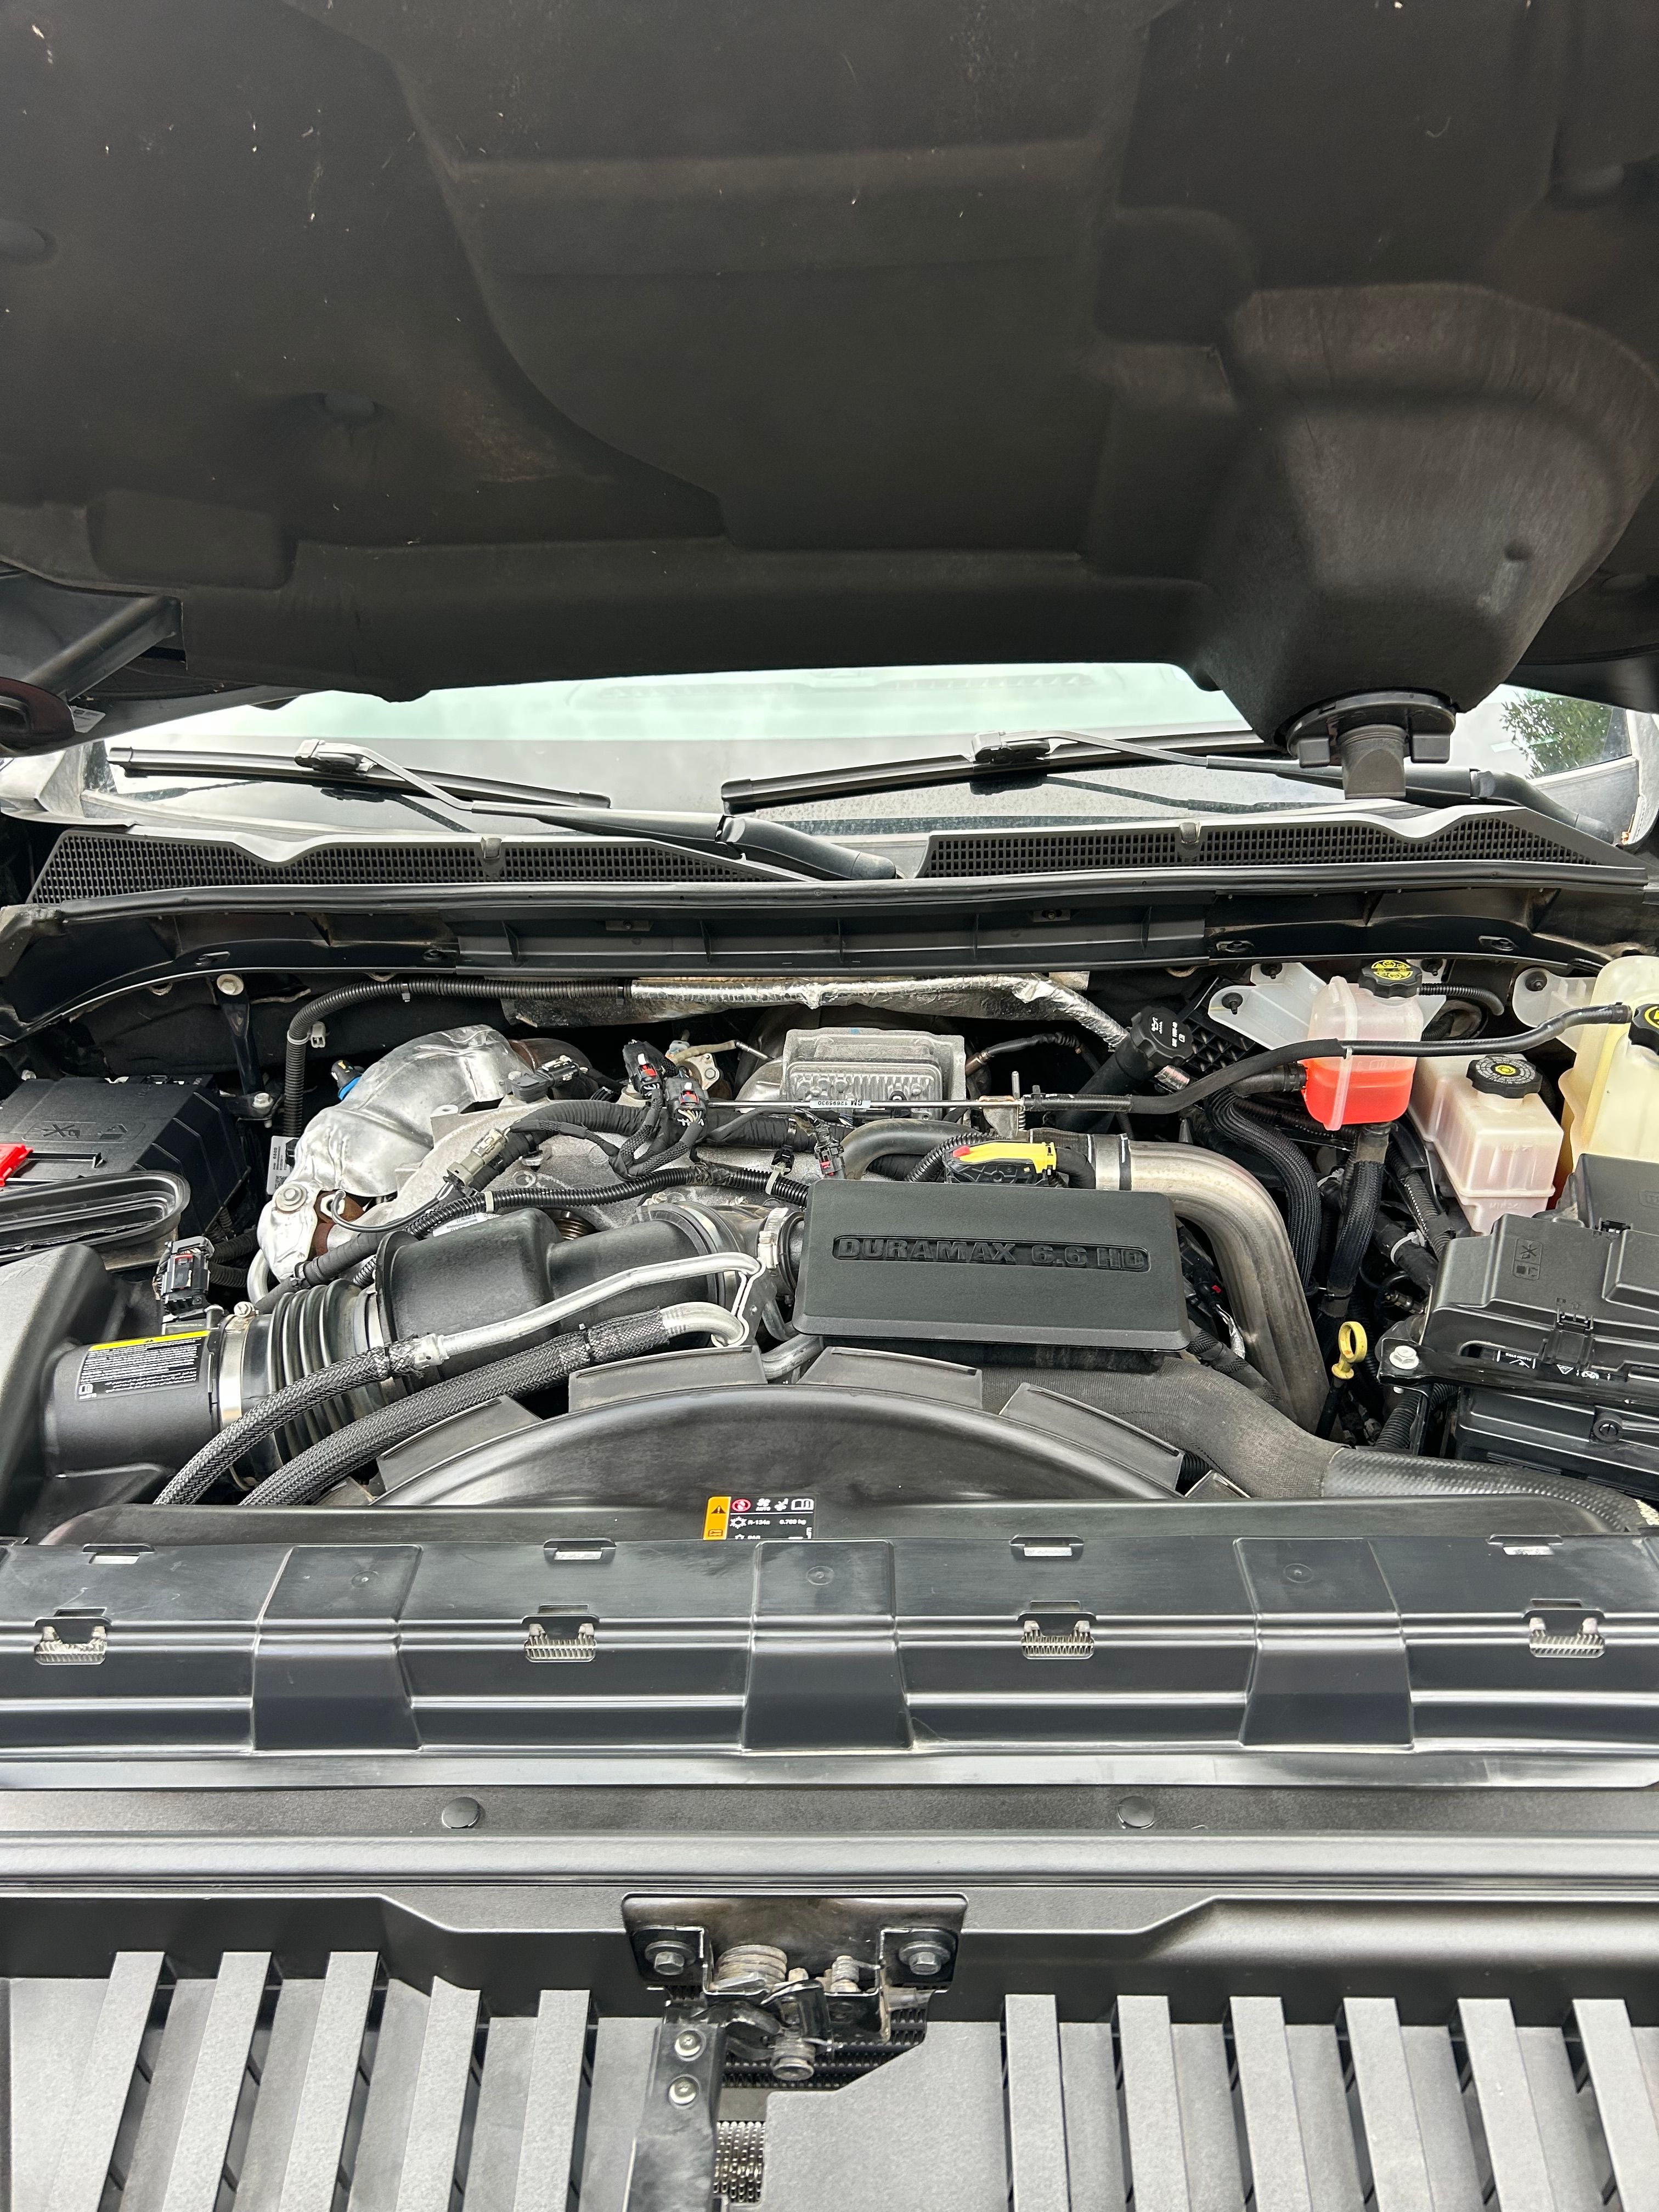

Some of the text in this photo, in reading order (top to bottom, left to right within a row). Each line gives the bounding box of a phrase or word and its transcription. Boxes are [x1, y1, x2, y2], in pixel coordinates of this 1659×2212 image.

[838, 1238, 1147, 1271] DURAMAX 6.6 HD
